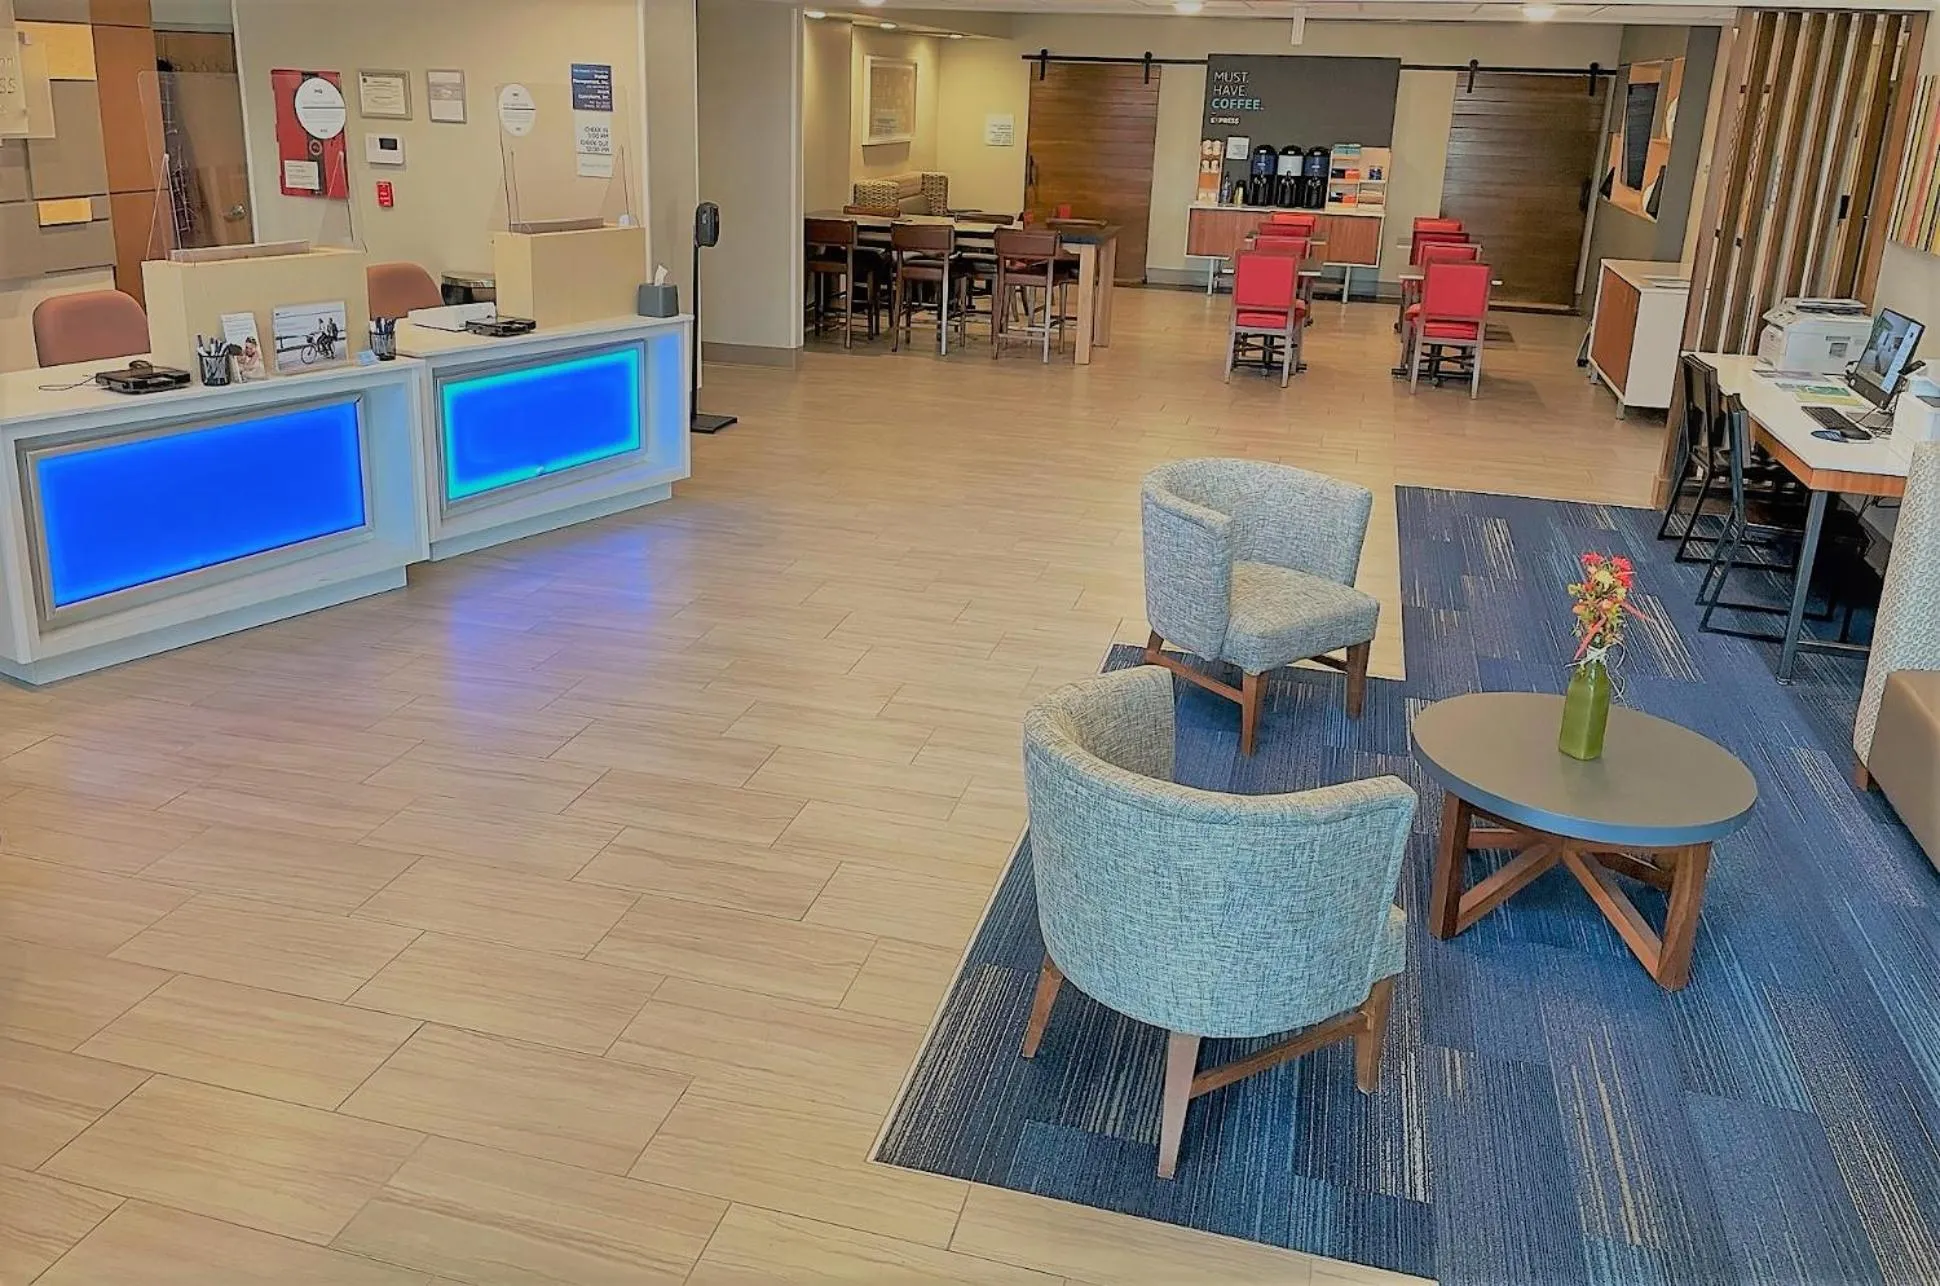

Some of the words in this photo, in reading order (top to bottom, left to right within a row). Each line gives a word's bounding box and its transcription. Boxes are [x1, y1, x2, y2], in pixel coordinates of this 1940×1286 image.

[1213, 71, 1249, 83] MUST.
[1213, 84, 1248, 97] HAVE.
[1212, 98, 1264, 110] COFFEE.
